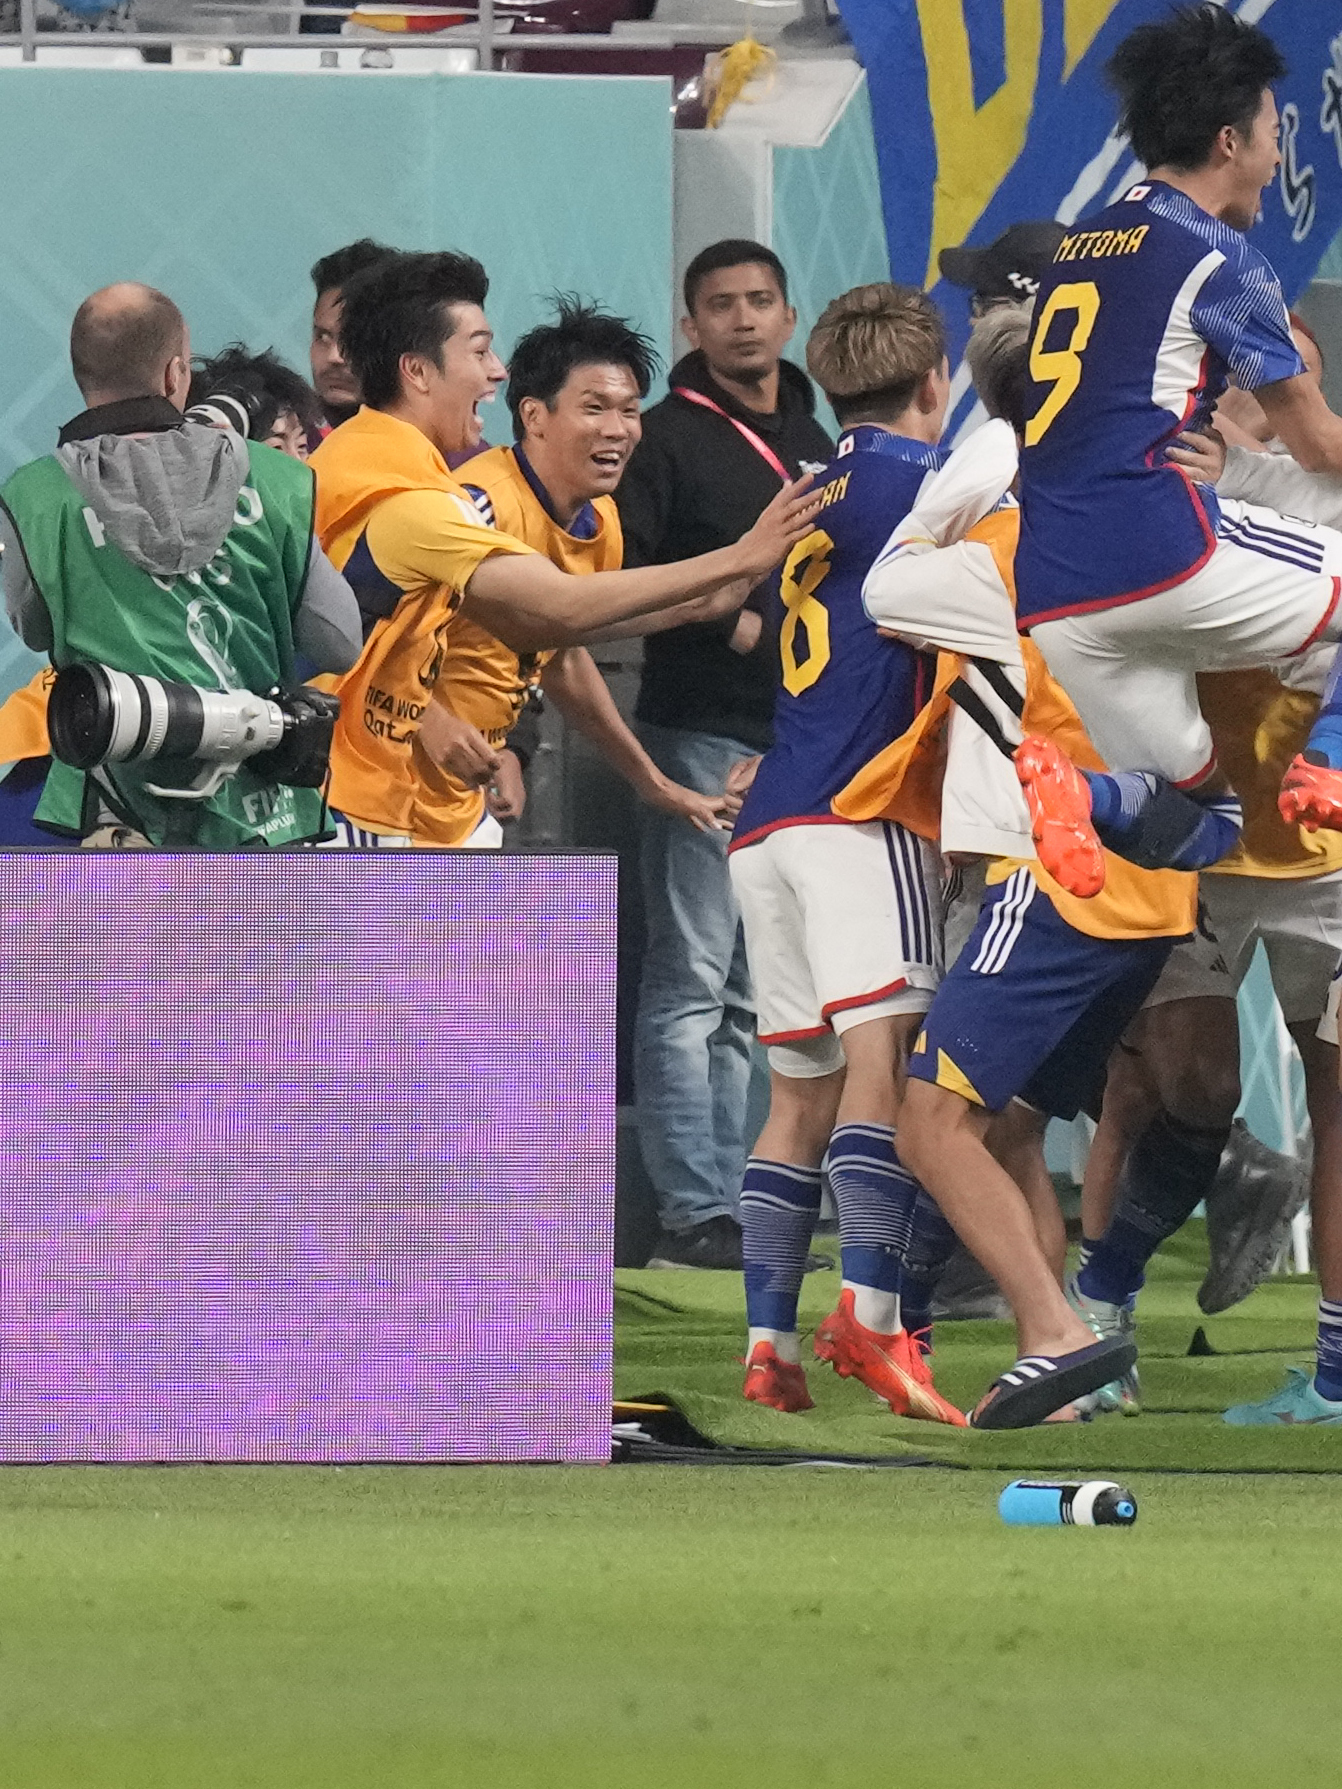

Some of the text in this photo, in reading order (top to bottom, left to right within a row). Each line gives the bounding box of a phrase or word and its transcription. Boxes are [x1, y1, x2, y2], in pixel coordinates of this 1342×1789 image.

[1053, 225, 1150, 264] MITOMA
[1025, 282, 1100, 447] 9
[780, 529, 835, 698] 8
